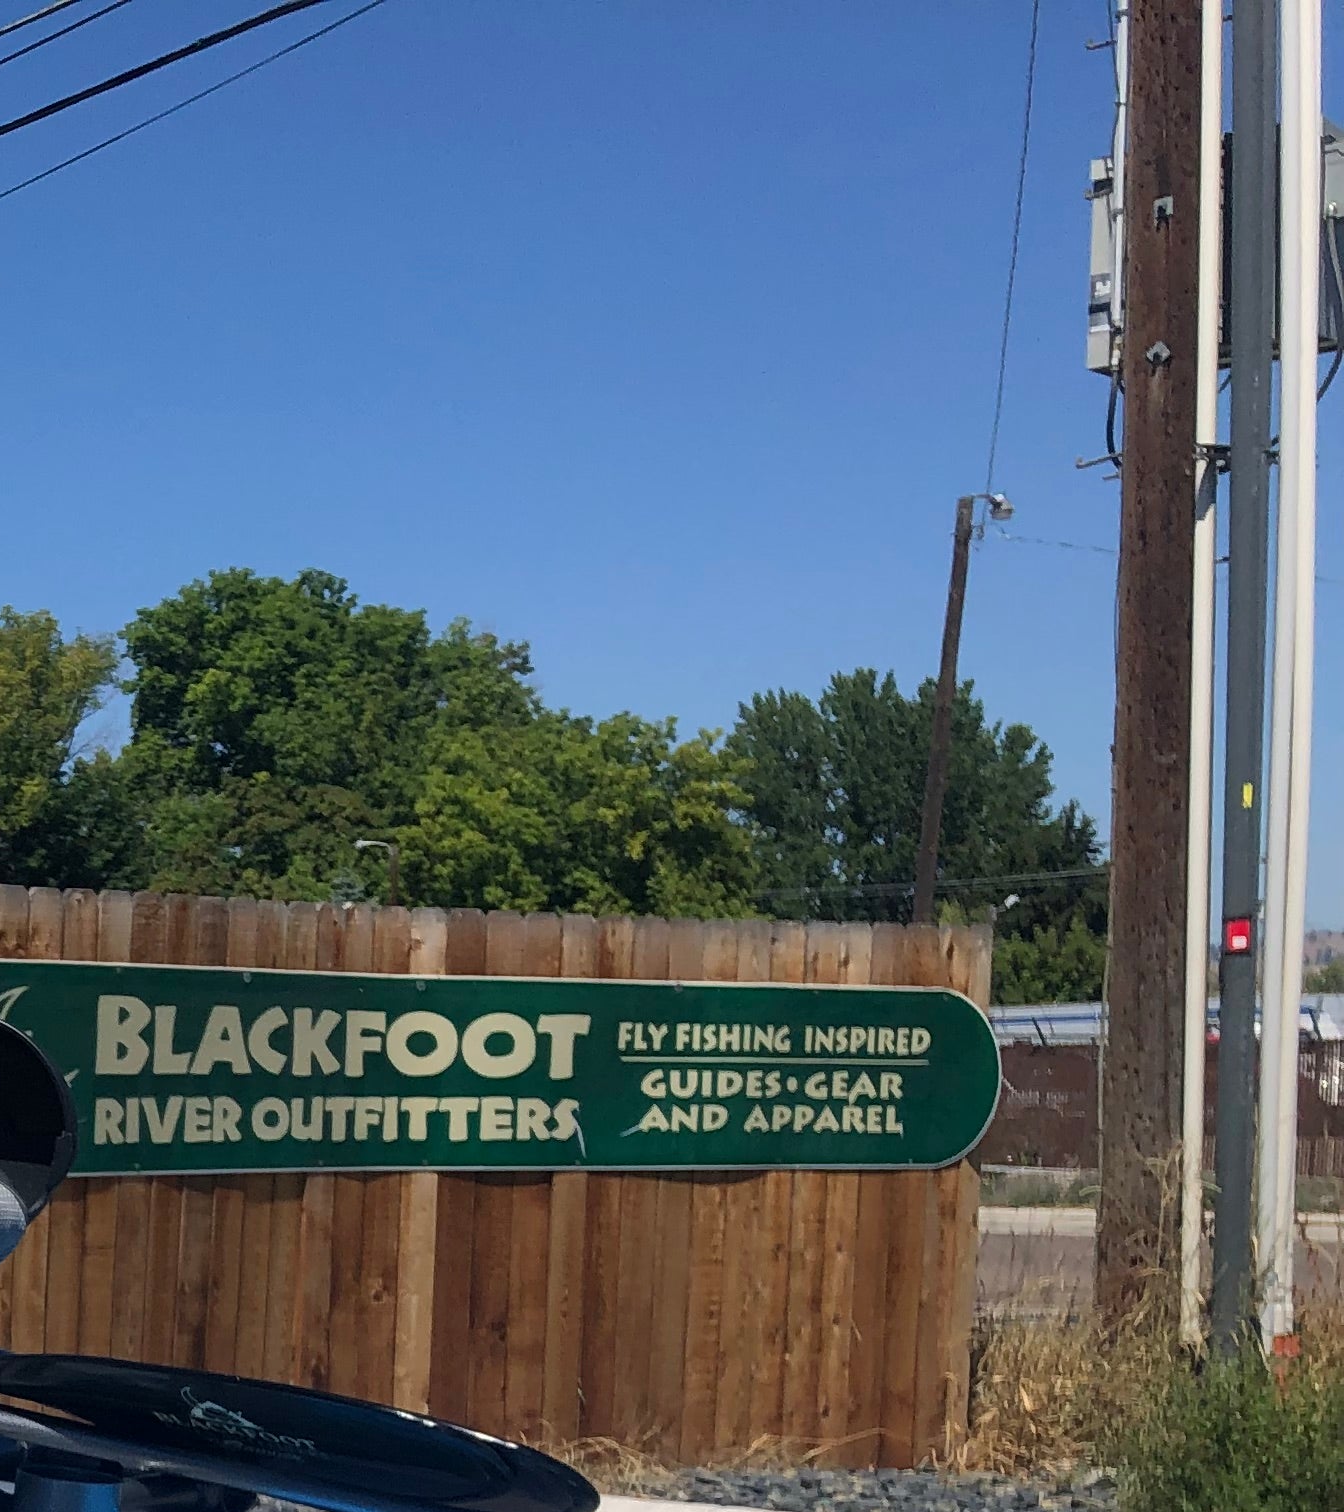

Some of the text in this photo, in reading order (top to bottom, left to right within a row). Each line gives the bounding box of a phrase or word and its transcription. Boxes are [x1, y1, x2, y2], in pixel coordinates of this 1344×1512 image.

[94, 995, 592, 1080] BLACKFOOT
[617, 1021, 932, 1057] FLY FISHING INSPIRED
[93, 1096, 582, 1146] RIVER OUTFITTERS
[639, 1103, 904, 1135] AND APPAREL
